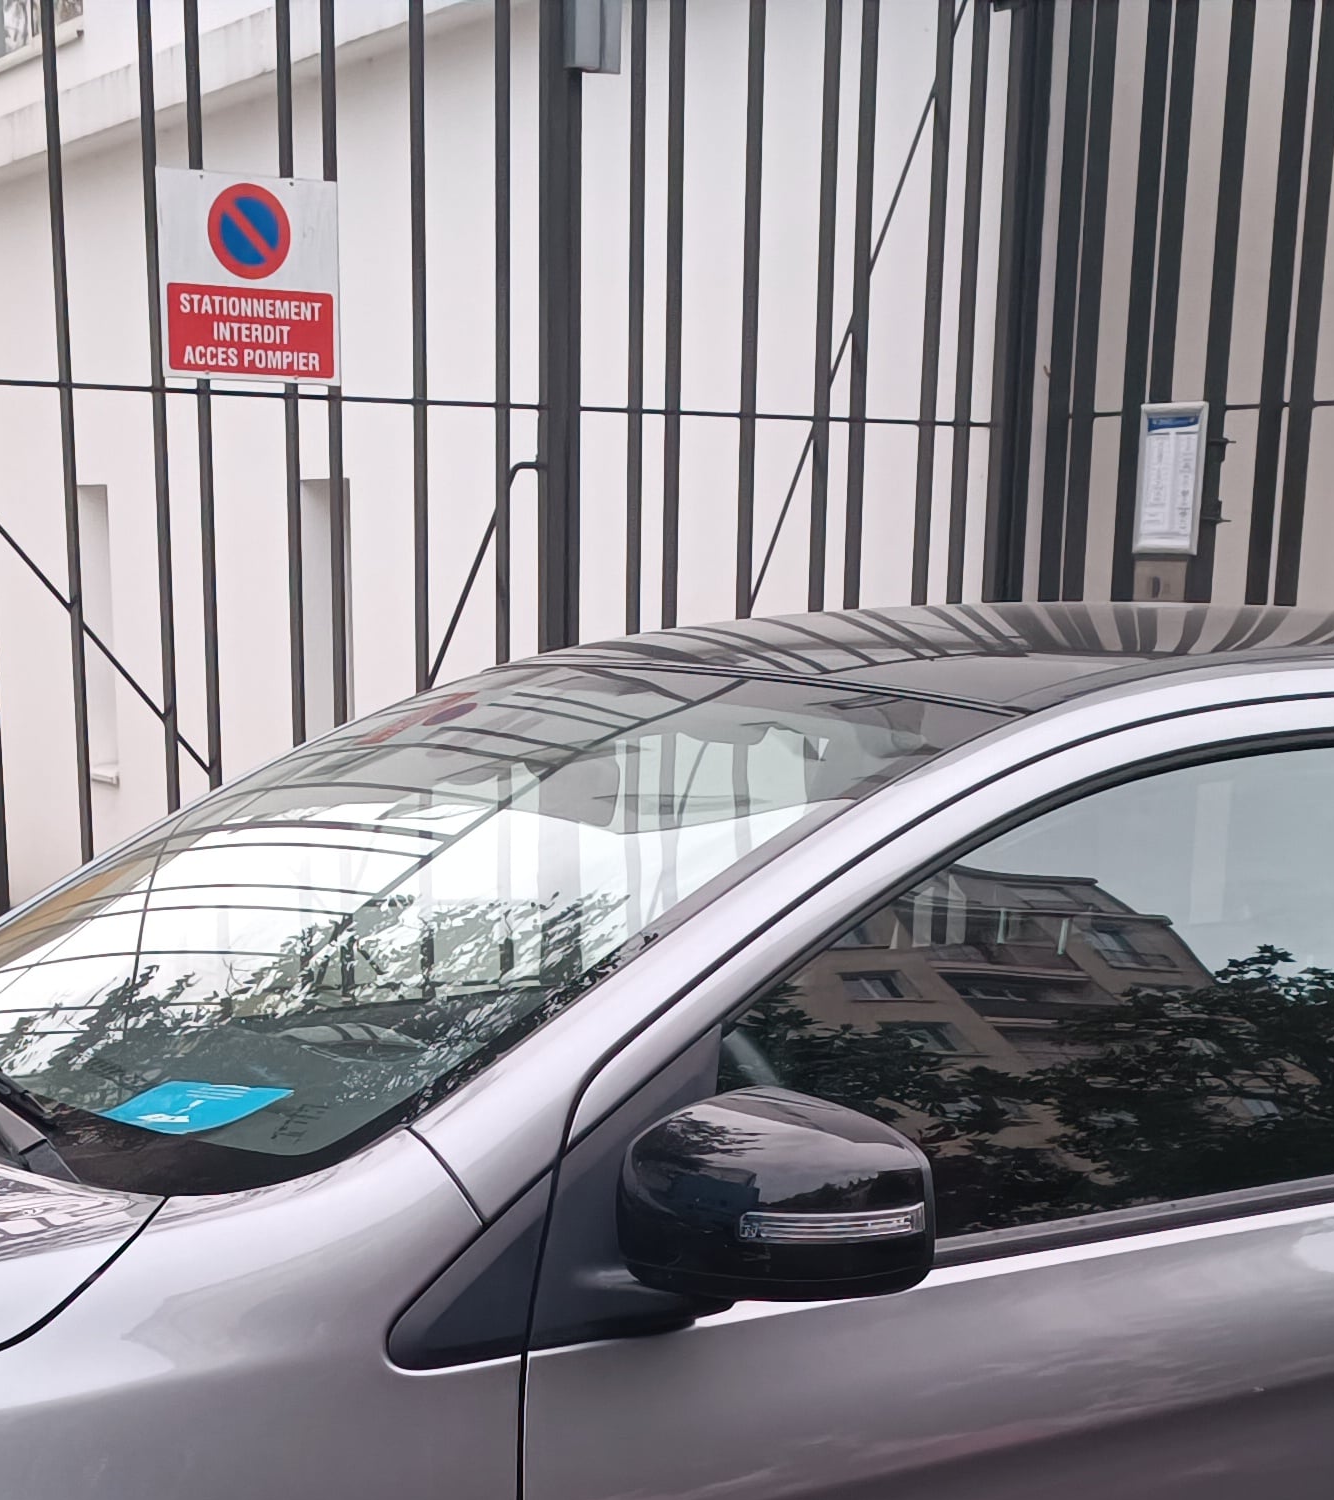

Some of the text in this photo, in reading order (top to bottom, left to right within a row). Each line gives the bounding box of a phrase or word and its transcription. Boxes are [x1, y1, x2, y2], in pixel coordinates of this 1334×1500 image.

[179, 293, 322, 321] STATIONNEMENT
[213, 321, 291, 344] INTERDIT
[183, 346, 320, 372] ACCES POMPIER
